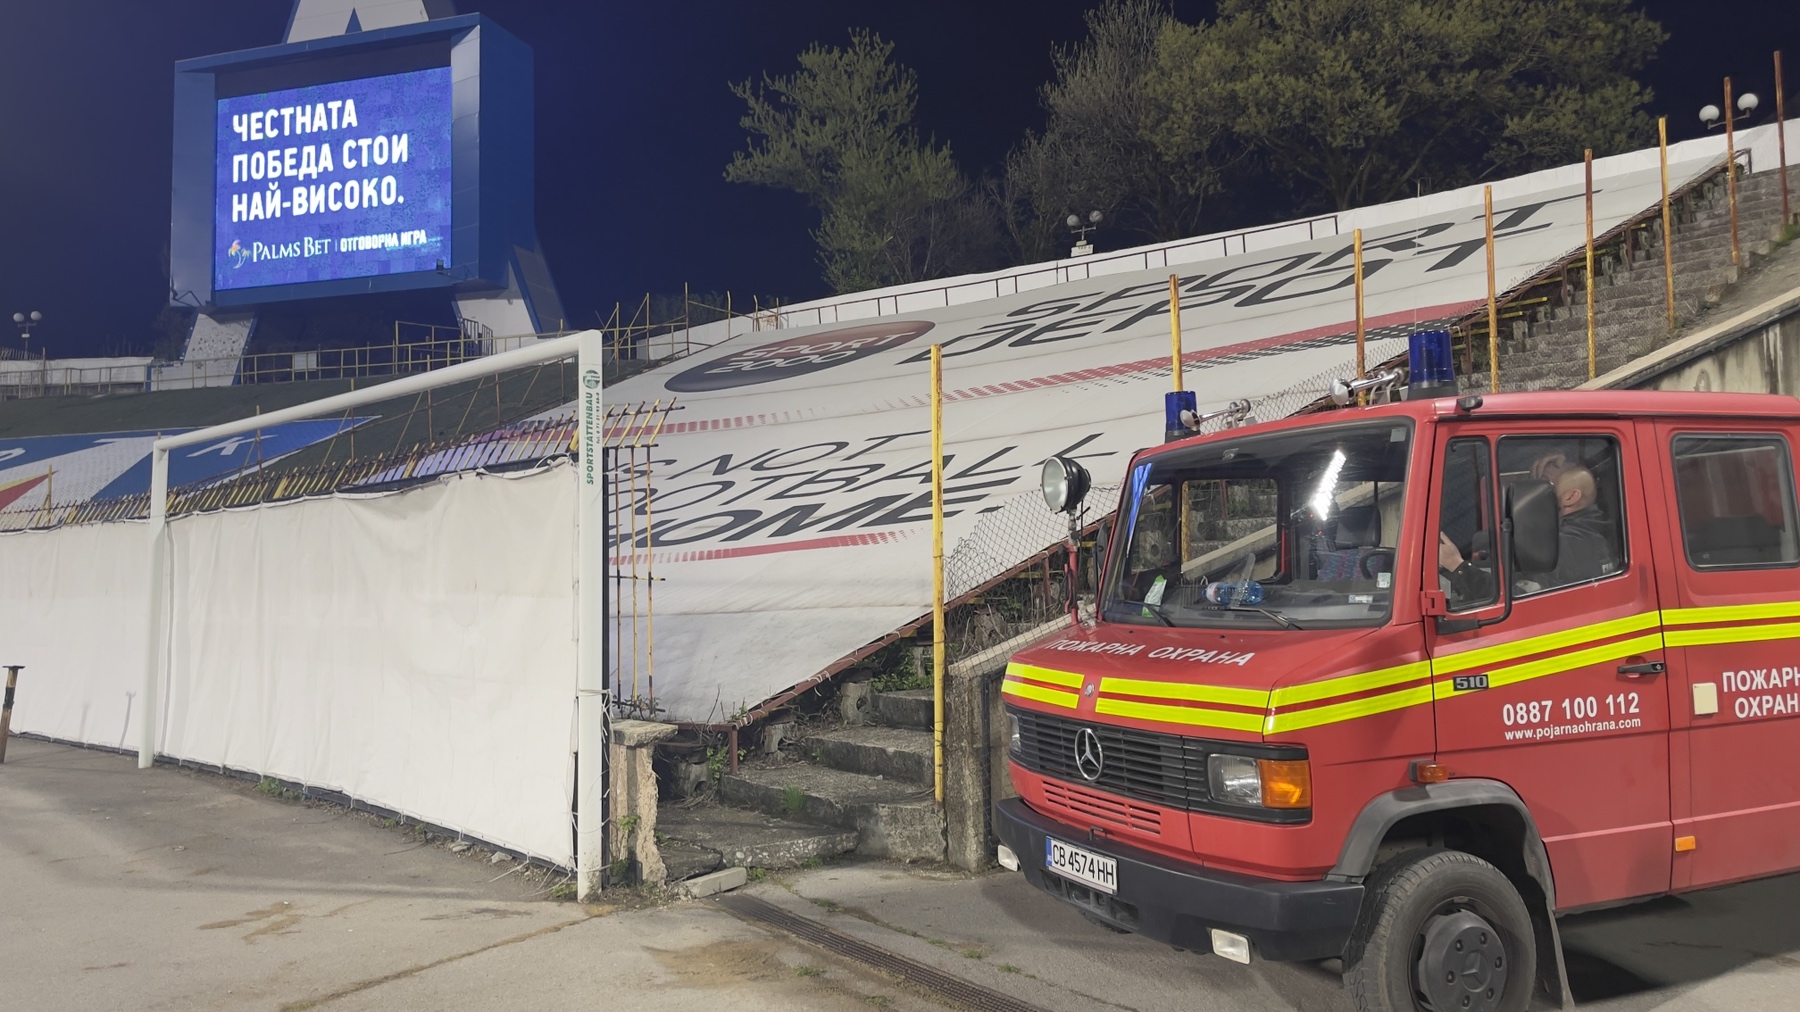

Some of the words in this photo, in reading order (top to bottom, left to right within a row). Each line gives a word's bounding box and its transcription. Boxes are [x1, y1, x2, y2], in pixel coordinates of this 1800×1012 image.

[232, 99, 358, 142] ЧЕСТНАТА
[232, 143, 334, 183] ПОБЕДА
[342, 133, 408, 169] СТОИ
[232, 175, 405, 223] НАЙ-ВИСОКО.
[340, 232, 399, 253] ОТГОВОРНА
[400, 229, 427, 248] ИГРА
[979, 189, 1603, 330] SPORT
[894, 222, 1554, 365] DEPOT
[704, 350, 857, 374] 2000
[729, 331, 916, 361] SPORT
[607, 433, 1119, 515] OOTBALL
[665, 430, 933, 480] NOT
[1045, 639, 1146, 656] ПОЖАРНА
[1148, 646, 1255, 666] ОХРАНА
[1456, 675, 1488, 689] 510
[1502, 700, 1553, 726] 0887
[1561, 696, 1598, 720] 100
[1605, 692, 1640, 715] 112
[1504, 718, 1641, 740] www.pojarnaohrana.com
